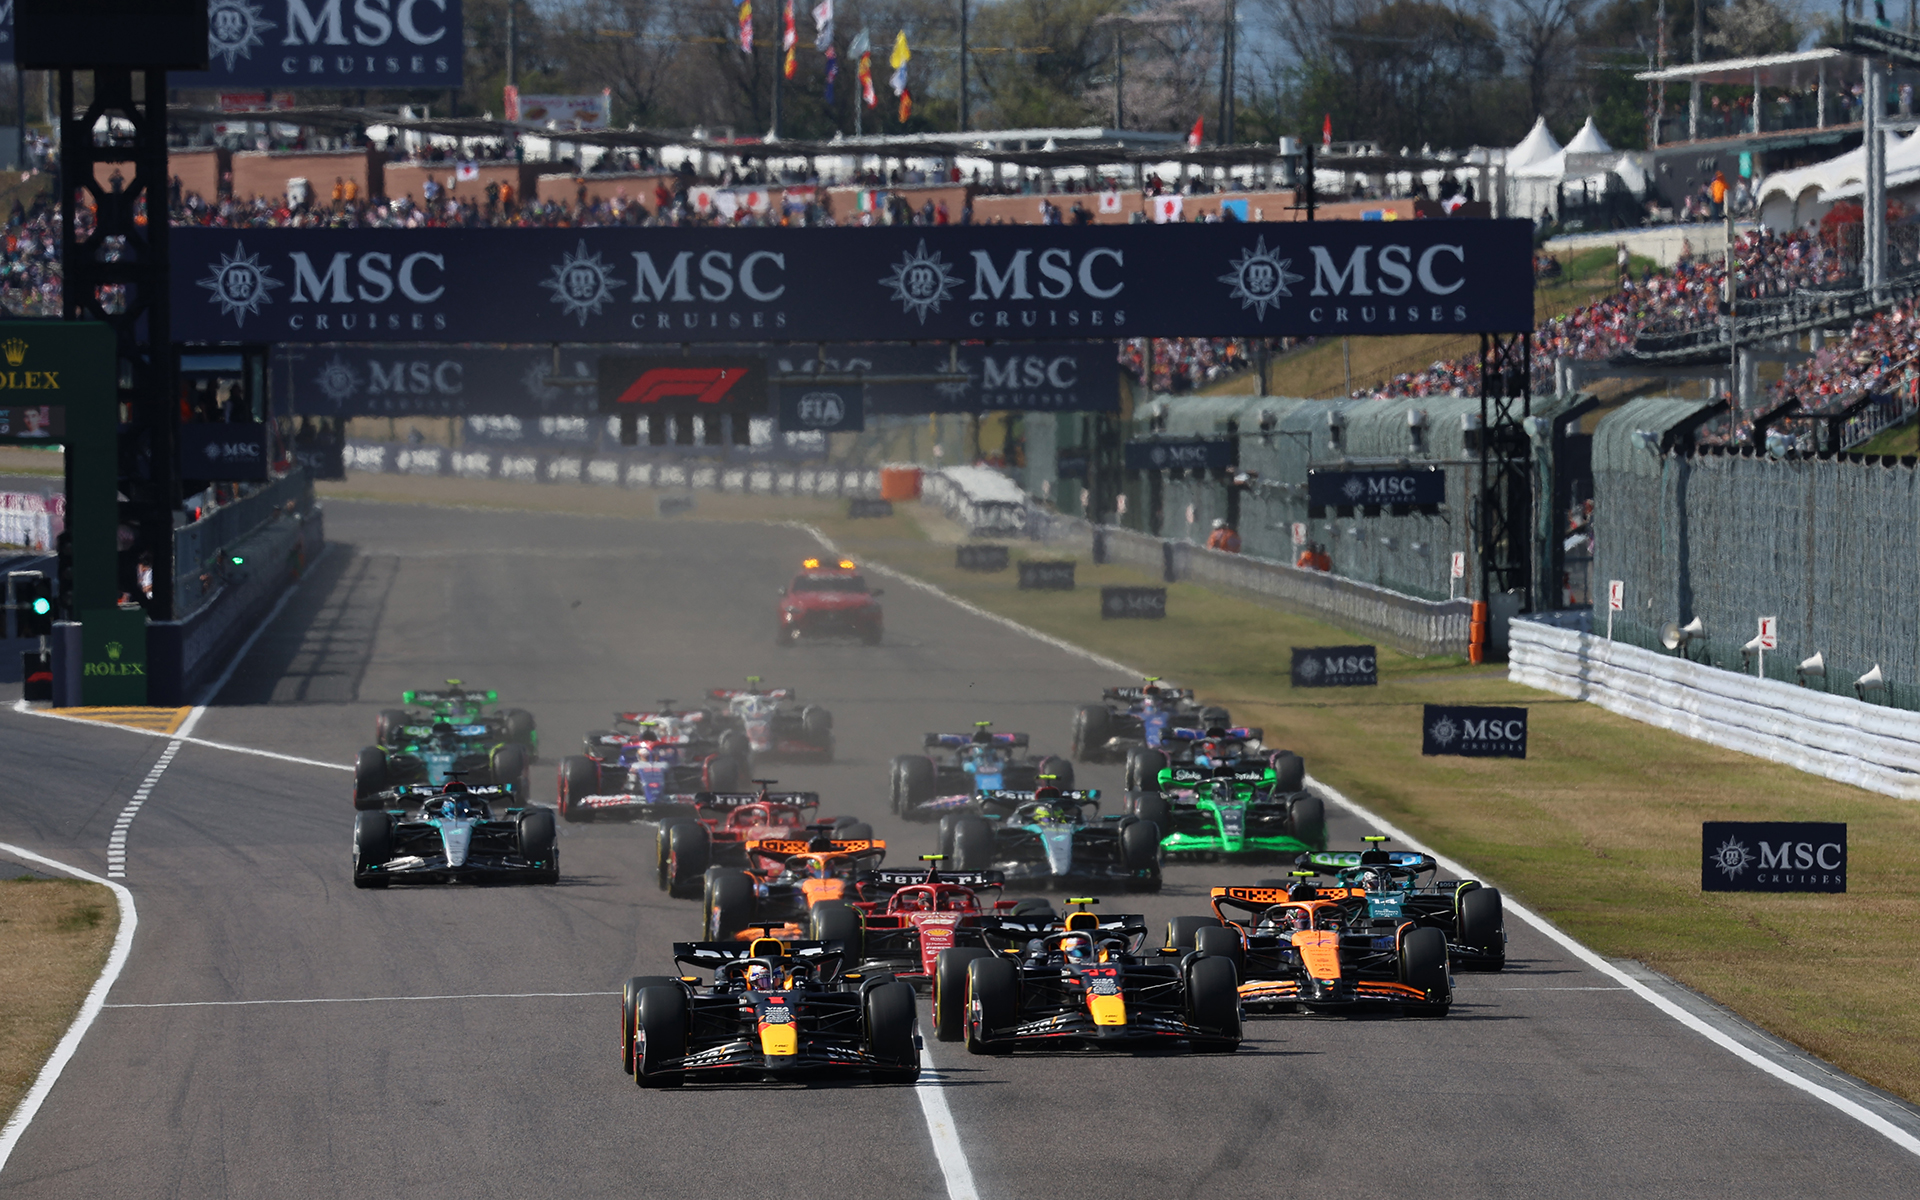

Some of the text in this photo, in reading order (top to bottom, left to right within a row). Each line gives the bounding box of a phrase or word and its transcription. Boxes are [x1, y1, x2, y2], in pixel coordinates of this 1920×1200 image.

[282, 0, 447, 47] MSC
[282, 56, 449, 74] CRUISES
[289, 251, 445, 303] MSC
[632, 250, 785, 303] MSC
[969, 248, 1124, 301] MSC
[1310, 244, 1465, 297] MSC
[290, 313, 446, 330] CRUISES
[632, 312, 786, 329] CRUISES
[969, 310, 1126, 327] CRUISES
[1309, 305, 1467, 323] CRUISES
[368, 361, 463, 395] MSC
[983, 356, 1077, 389] MSC
[223, 443, 260, 457] MSC
[1368, 476, 1416, 495] MSC
[84, 662, 146, 677] ROLEX
[1325, 656, 1376, 675] MSC
[1462, 719, 1523, 741] MSC
[1757, 841, 1841, 871] MSC
[1757, 873, 1842, 884] CRUISES
